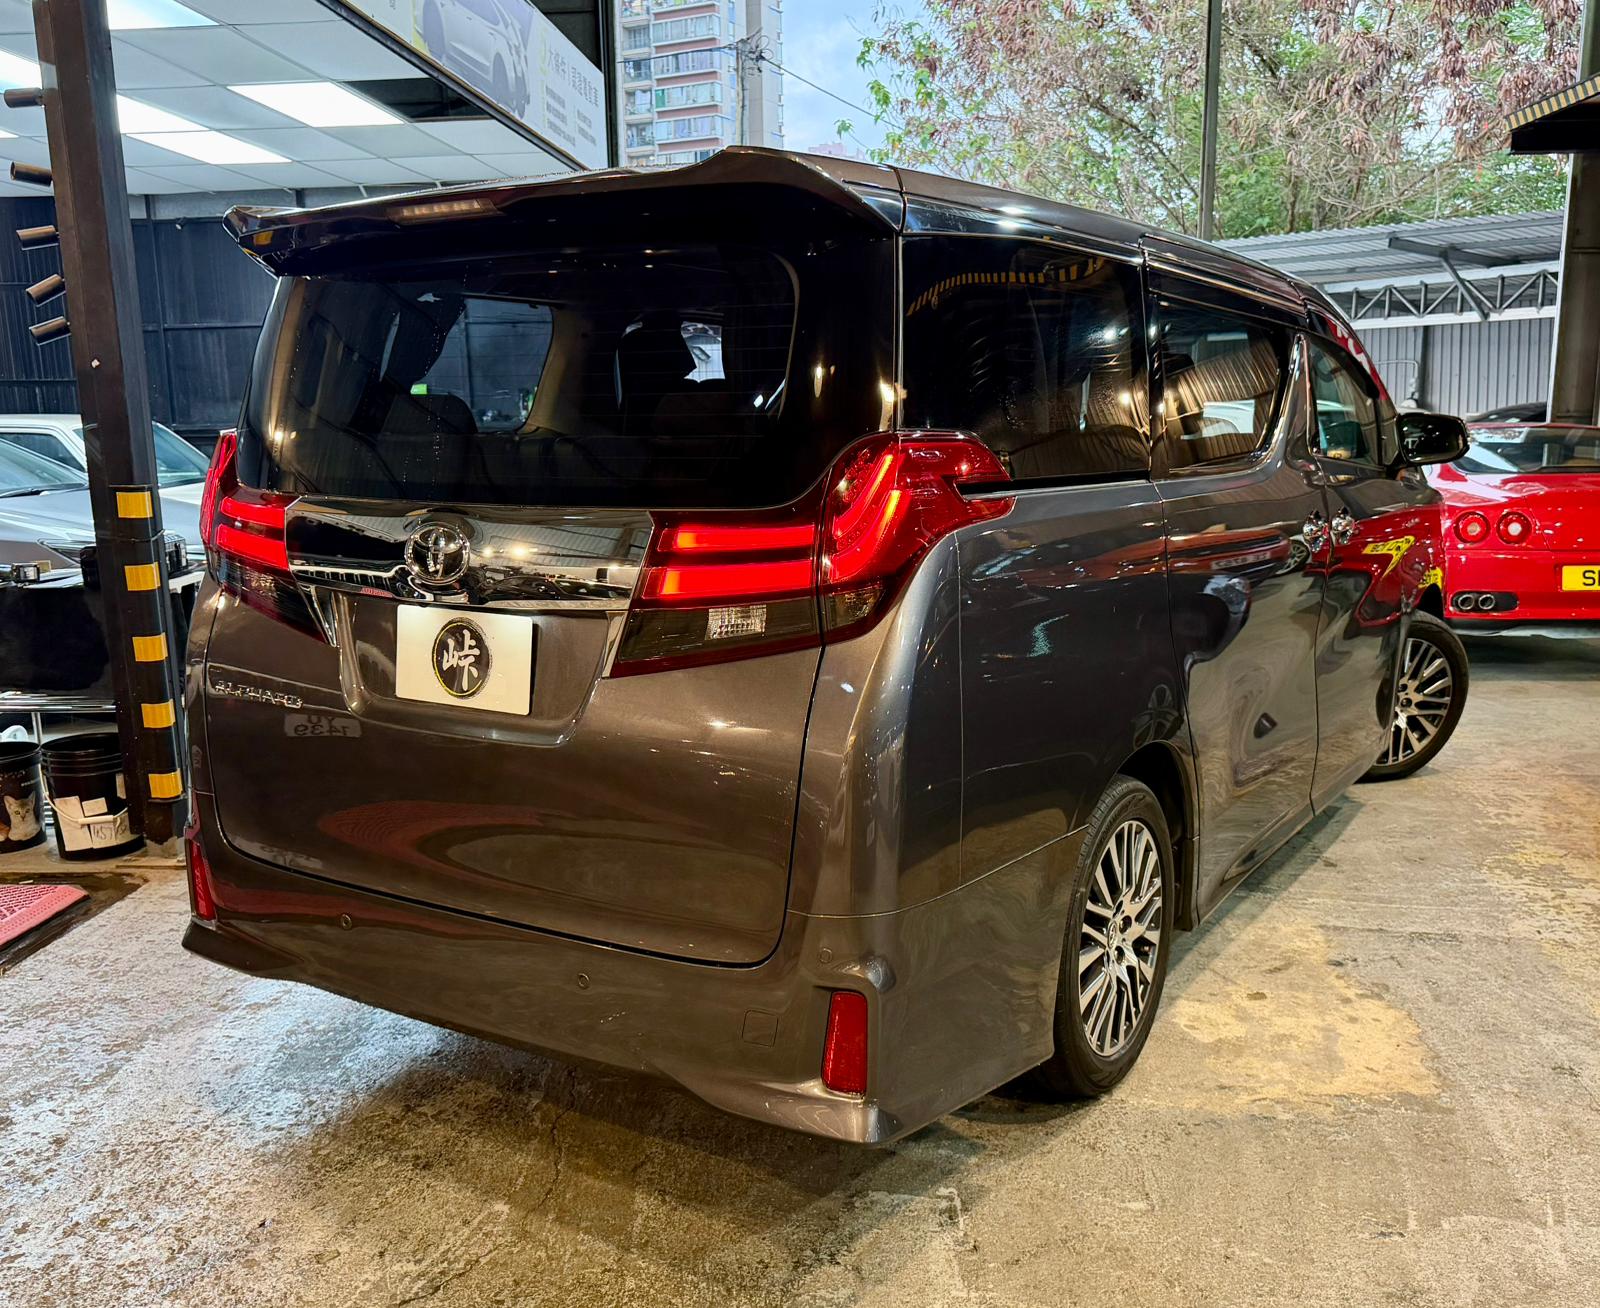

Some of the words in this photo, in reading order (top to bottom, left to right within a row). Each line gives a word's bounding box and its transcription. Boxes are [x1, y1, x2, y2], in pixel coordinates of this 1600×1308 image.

[1582, 569, 1600, 587] S
[442, 629, 481, 691] 峠
[214, 680, 303, 709] ALPHARD
